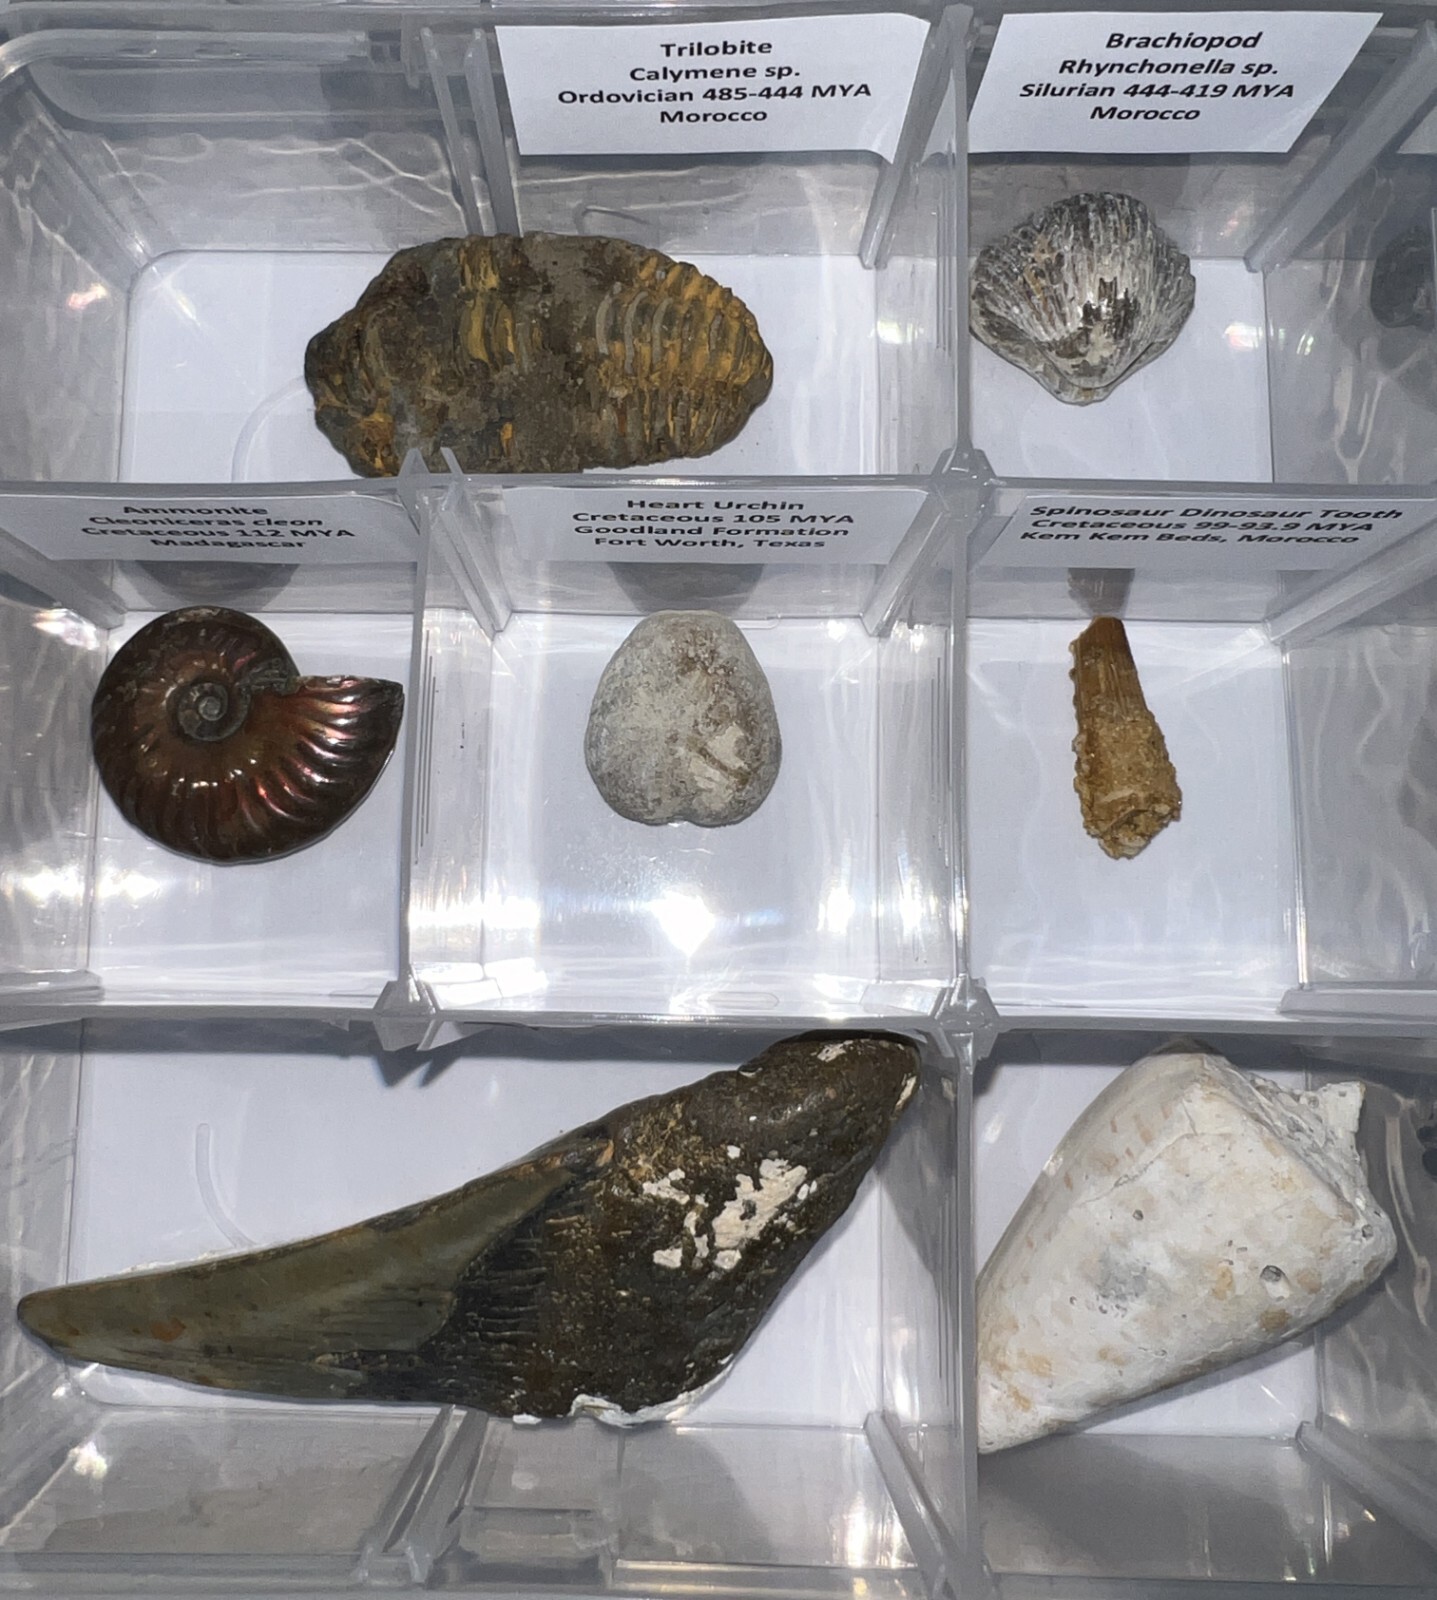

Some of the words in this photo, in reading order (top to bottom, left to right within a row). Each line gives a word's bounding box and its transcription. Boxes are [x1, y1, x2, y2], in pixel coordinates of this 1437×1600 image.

[1106, 32, 1263, 52] Brachiopod
[660, 40, 772, 57] Trilobite
[1059, 59, 1235, 77] Rhynchonella
[1241, 63, 1277, 77] sp.
[630, 67, 757, 83] Calymene
[765, 66, 800, 80] sp.
[558, 89, 693, 103] Ordovician
[703, 86, 803, 100] 485-444
[812, 84, 871, 97] MYA
[1020, 83, 1115, 97] Silurian
[1123, 84, 1228, 97] 444-419
[1232, 85, 1293, 97] MYA
[661, 111, 767, 123] Morocco
[1090, 106, 1200, 120] Morocco
[124, 506, 268, 515] Ammonite
[628, 500, 704, 510] Heart
[714, 501, 804, 511] Urchin
[573, 513, 723, 523] Cretaceous
[733, 515, 780, 524] 105
[790, 515, 853, 524] MYA
[1030, 506, 1174, 517] Spinosaur
[1179, 508, 1312, 519] Dinosaur
[1320, 510, 1402, 519] Tooth
[89, 517, 245, 527] Cleoniceras
[253, 518, 322, 527] cleon
[1032, 520, 1187, 530] Cretaceous
[1305, 523, 1373, 532] MYA
[81, 528, 230, 537] Cretaceous
[237, 530, 285, 538] 112
[575, 526, 702, 535] Goodland
[713, 527, 848, 536] Formation
[150, 539, 305, 549] Madagascar
[595, 538, 646, 547] Fort
[655, 539, 744, 549] Worth,
[754, 540, 824, 548] Texas
[1021, 532, 1080, 541] Kem
[1089, 533, 1149, 541] Kem
[1156, 533, 1227, 544] Beds,
[1237, 535, 1359, 544] Morocco
